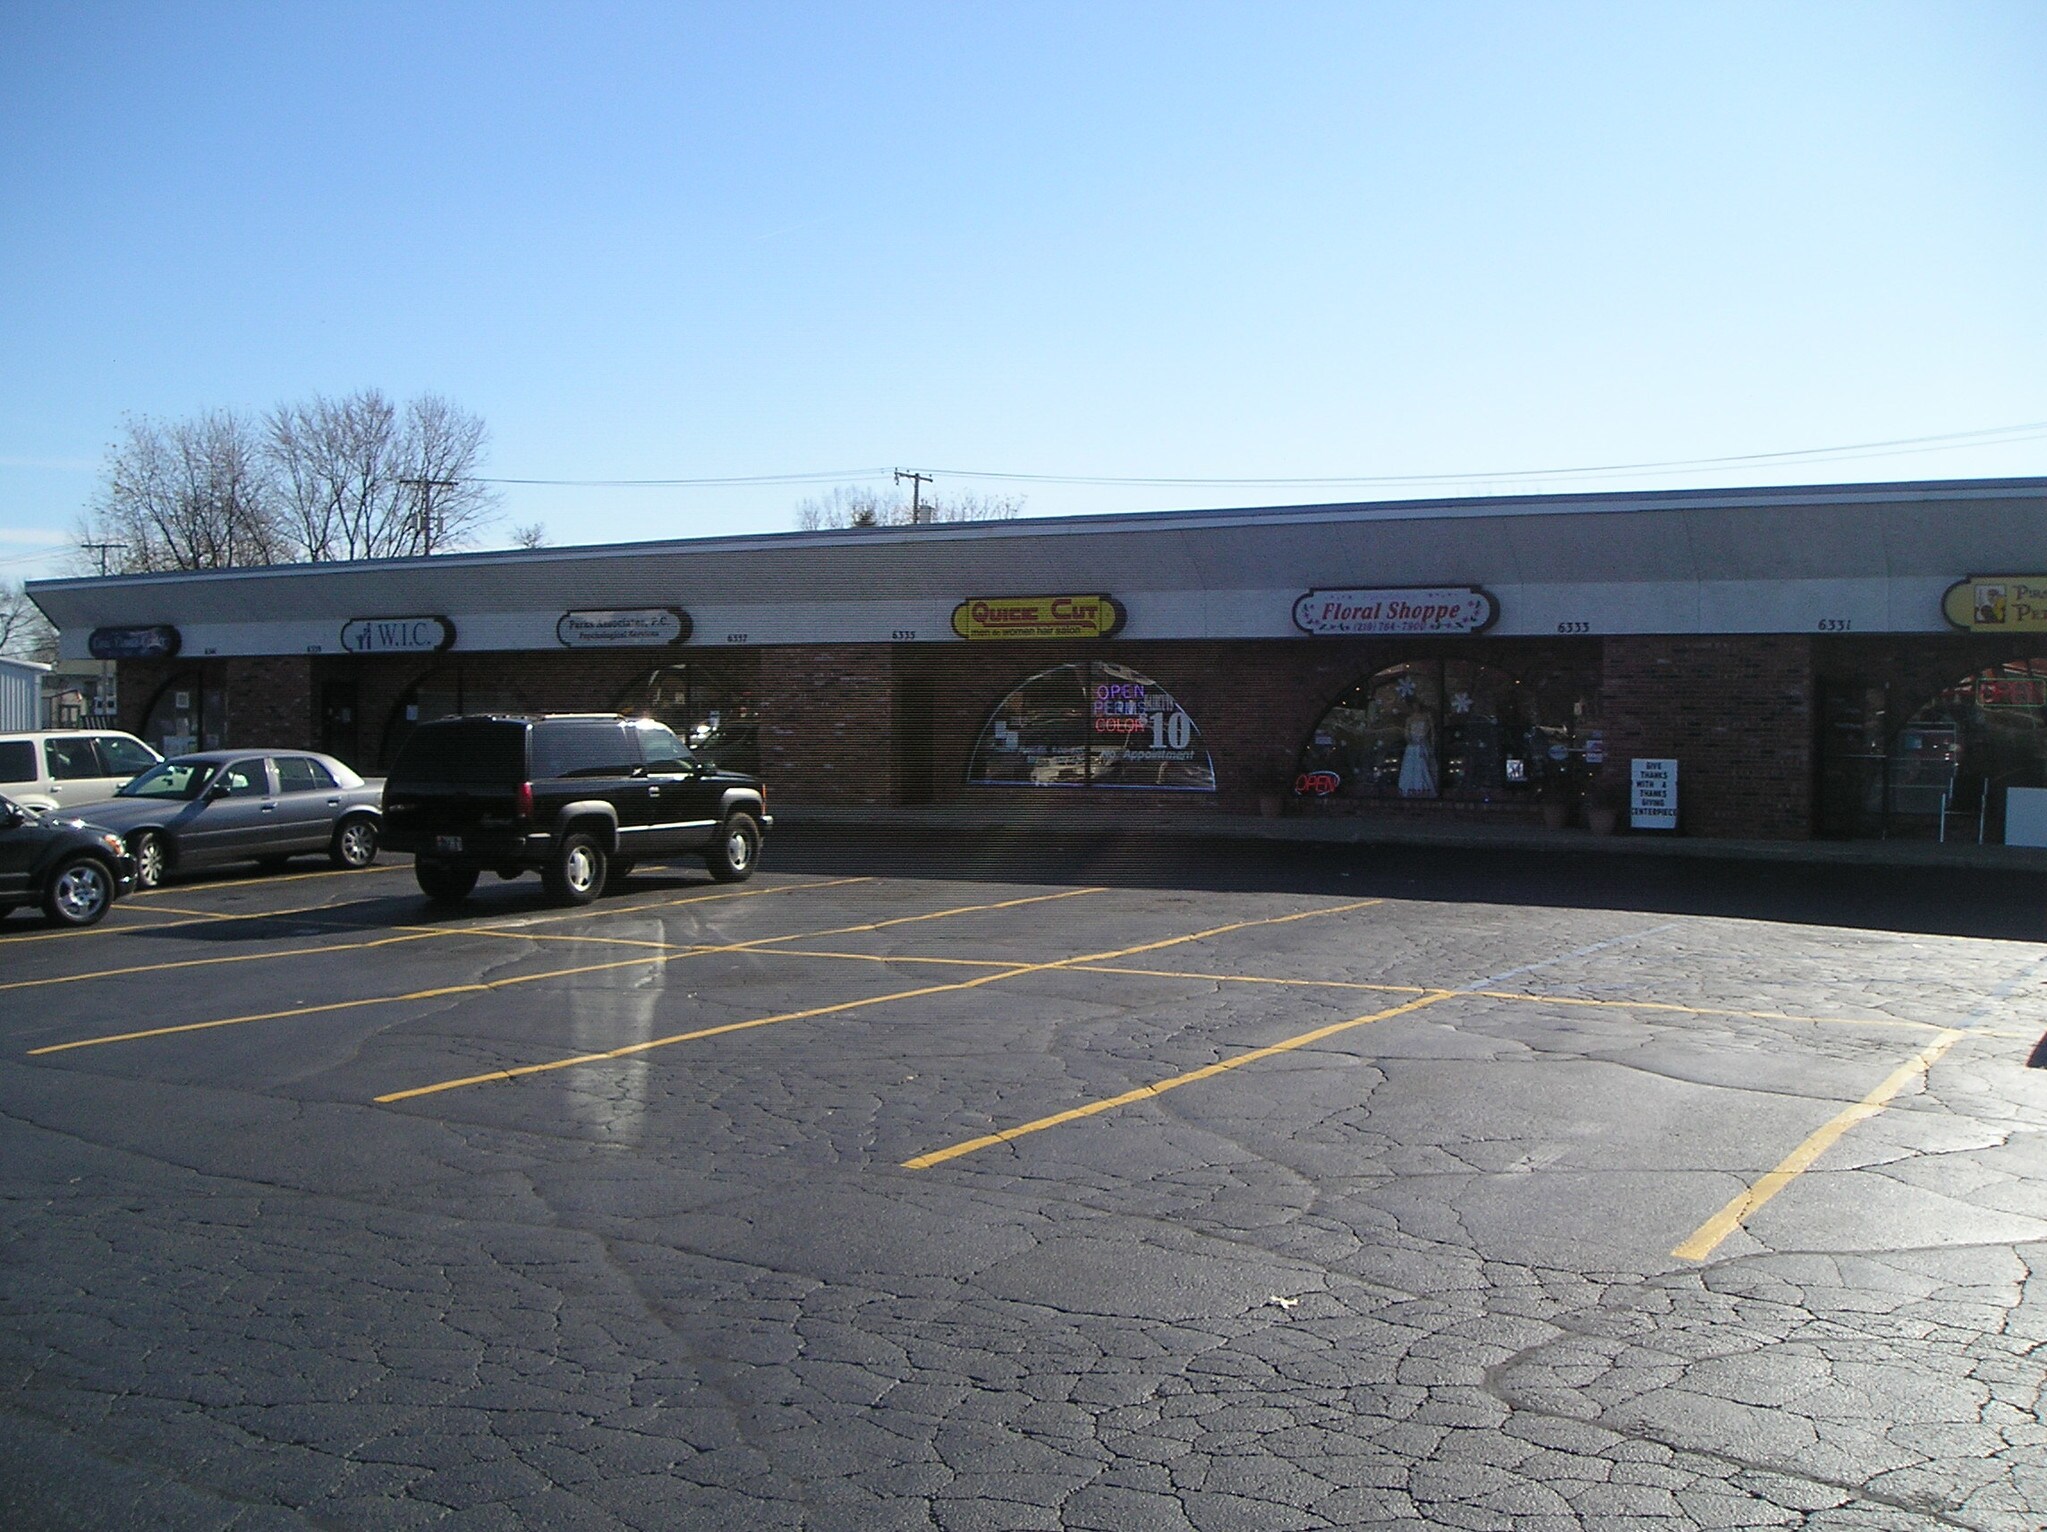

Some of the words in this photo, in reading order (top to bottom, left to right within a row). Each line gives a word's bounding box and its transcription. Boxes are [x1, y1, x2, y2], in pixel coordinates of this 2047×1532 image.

[1051, 599, 1098, 620] CUT
[1322, 603, 1382, 620] Floral
[1387, 602, 1460, 624] Shoppe
[1558, 622, 1589, 633] 6333
[1818, 619, 1851, 630] 6331
[378, 622, 431, 647] W.I.C.
[892, 630, 916, 639] 6335
[1002, 628, 1035, 636] women
[1055, 626, 1081, 634] salon
[1097, 684, 1144, 699] OPEN
[1094, 700, 1146, 715] PERMS
[1095, 718, 1144, 732] COLOR
[1122, 750, 1194, 760] Appointment
[1646, 762, 1661, 770] GIVE
[1640, 771, 1668, 779] THANKS
[1296, 774, 1337, 793] OPEN
[1640, 789, 1667, 798] THANKS
[1642, 798, 1665, 806] GIVING
[1631, 808, 1677, 816] CENTERPIECE
